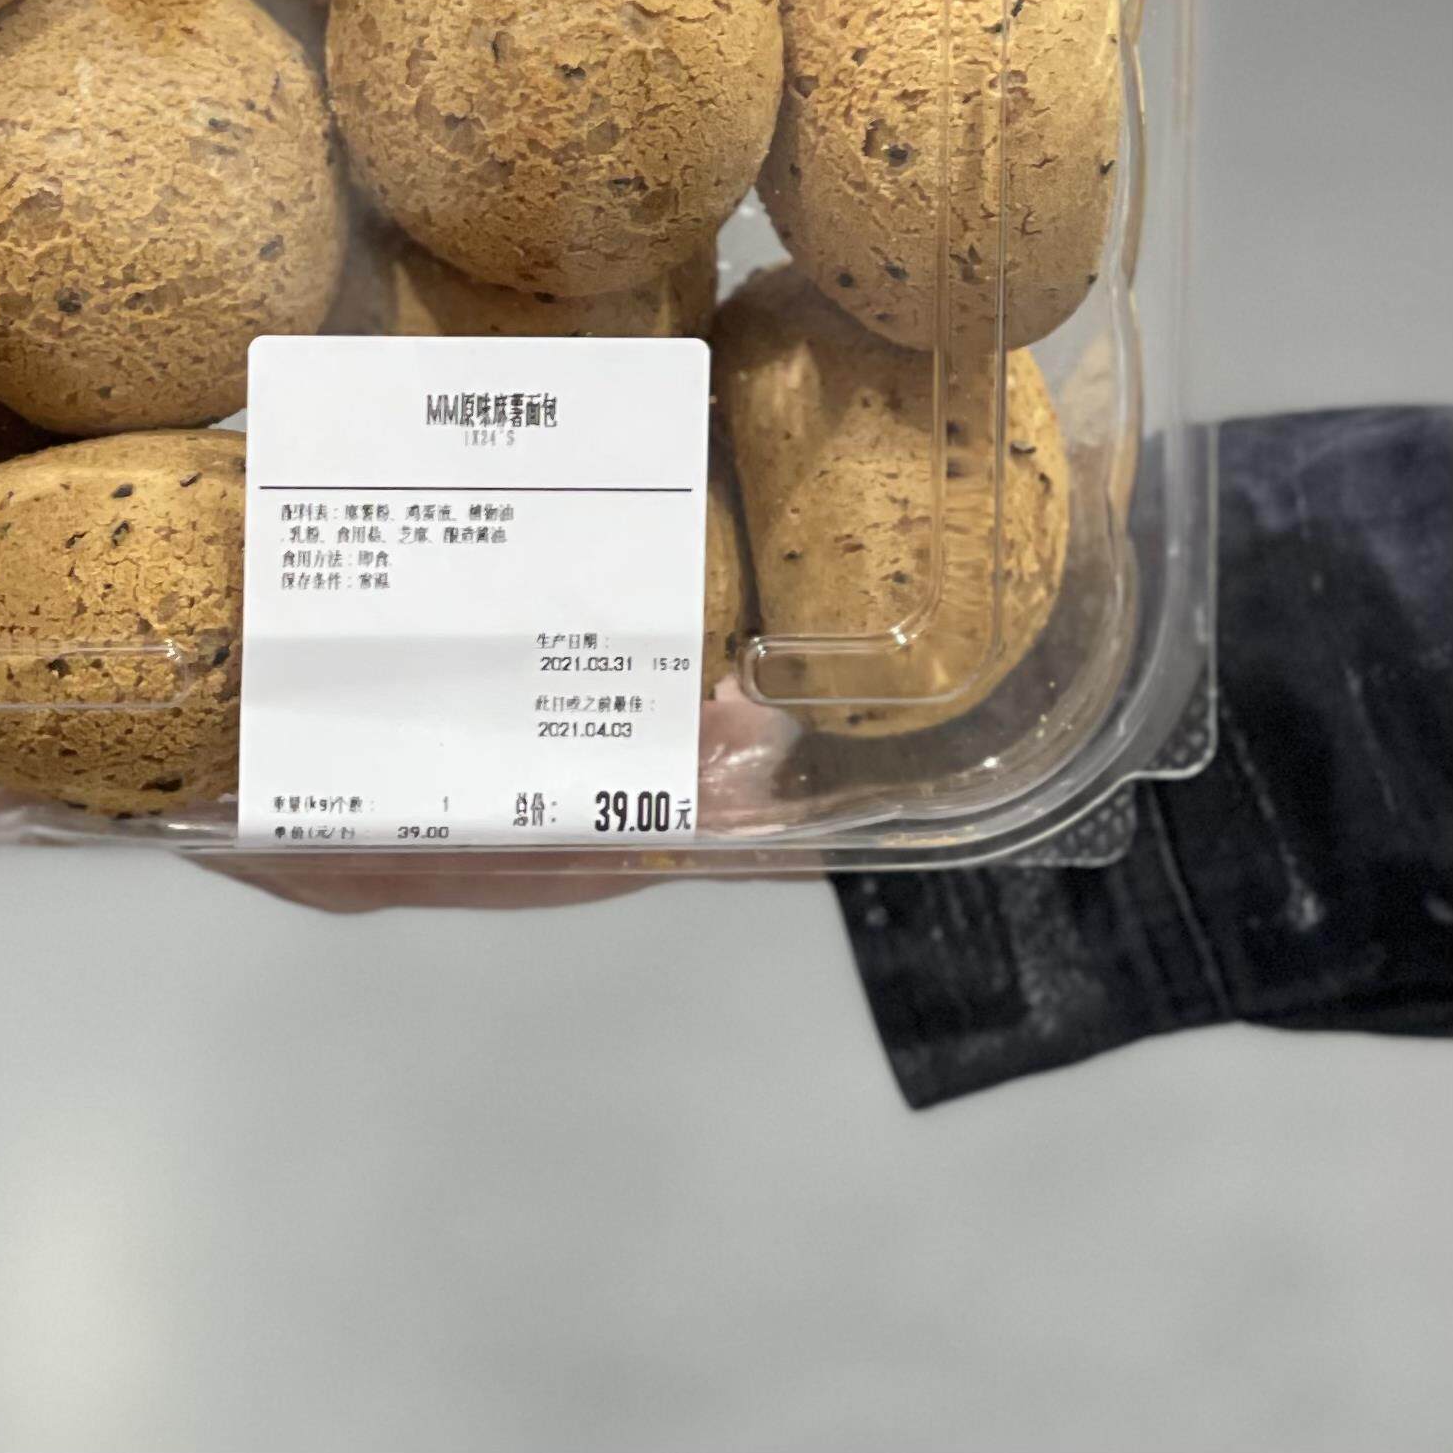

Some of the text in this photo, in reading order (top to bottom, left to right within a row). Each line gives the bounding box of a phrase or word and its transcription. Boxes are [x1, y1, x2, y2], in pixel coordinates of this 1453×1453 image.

[539, 656, 690, 672] 2021.03.31 15:20
[537, 721, 633, 738] 2021.04.03
[397, 826, 449, 839] 39.00
